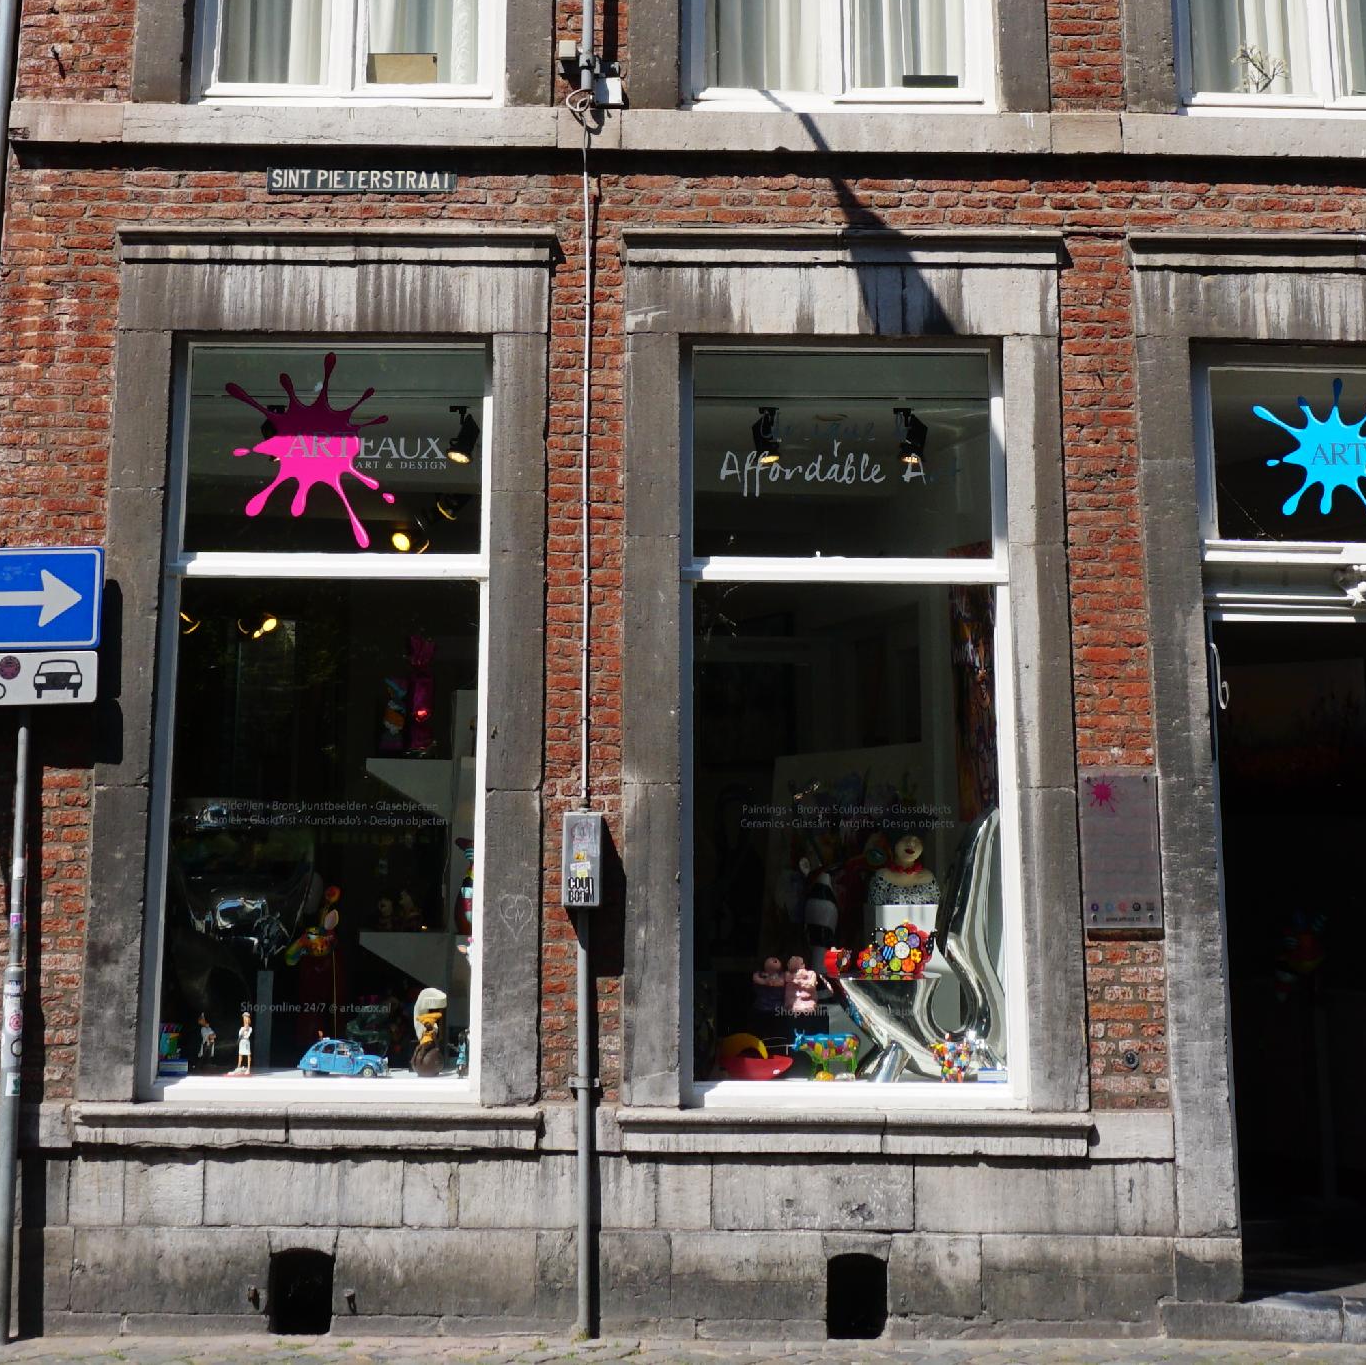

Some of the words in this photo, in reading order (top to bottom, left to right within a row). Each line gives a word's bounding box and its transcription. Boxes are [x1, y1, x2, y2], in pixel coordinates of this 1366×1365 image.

[271, 169, 311, 188] SINT
[284, 431, 447, 459] ARTEAUX
[356, 461, 379, 469] ART
[385, 461, 394, 469] &
[400, 461, 447, 470] DESIGN
[720, 450, 886, 497] Affordable
[742, 803, 787, 816] Paintings
[797, 803, 831, 814] Bronze
[833, 803, 884, 817] Sculptures
[891, 803, 952, 816] Glassobjects
[369, 814, 404, 828] Design
[406, 813, 449, 828] objecten
[740, 818, 785, 828] Ceramics
[839, 817, 875, 830] Artgifts
[882, 817, 917, 830] Design
[918, 817, 955, 830] objects
[240, 1001, 267, 1015] Shop
[269, 1001, 302, 1013] online
[303, 1002, 326, 1014] 24/7
[803, 1005, 834, 1017] onlin
